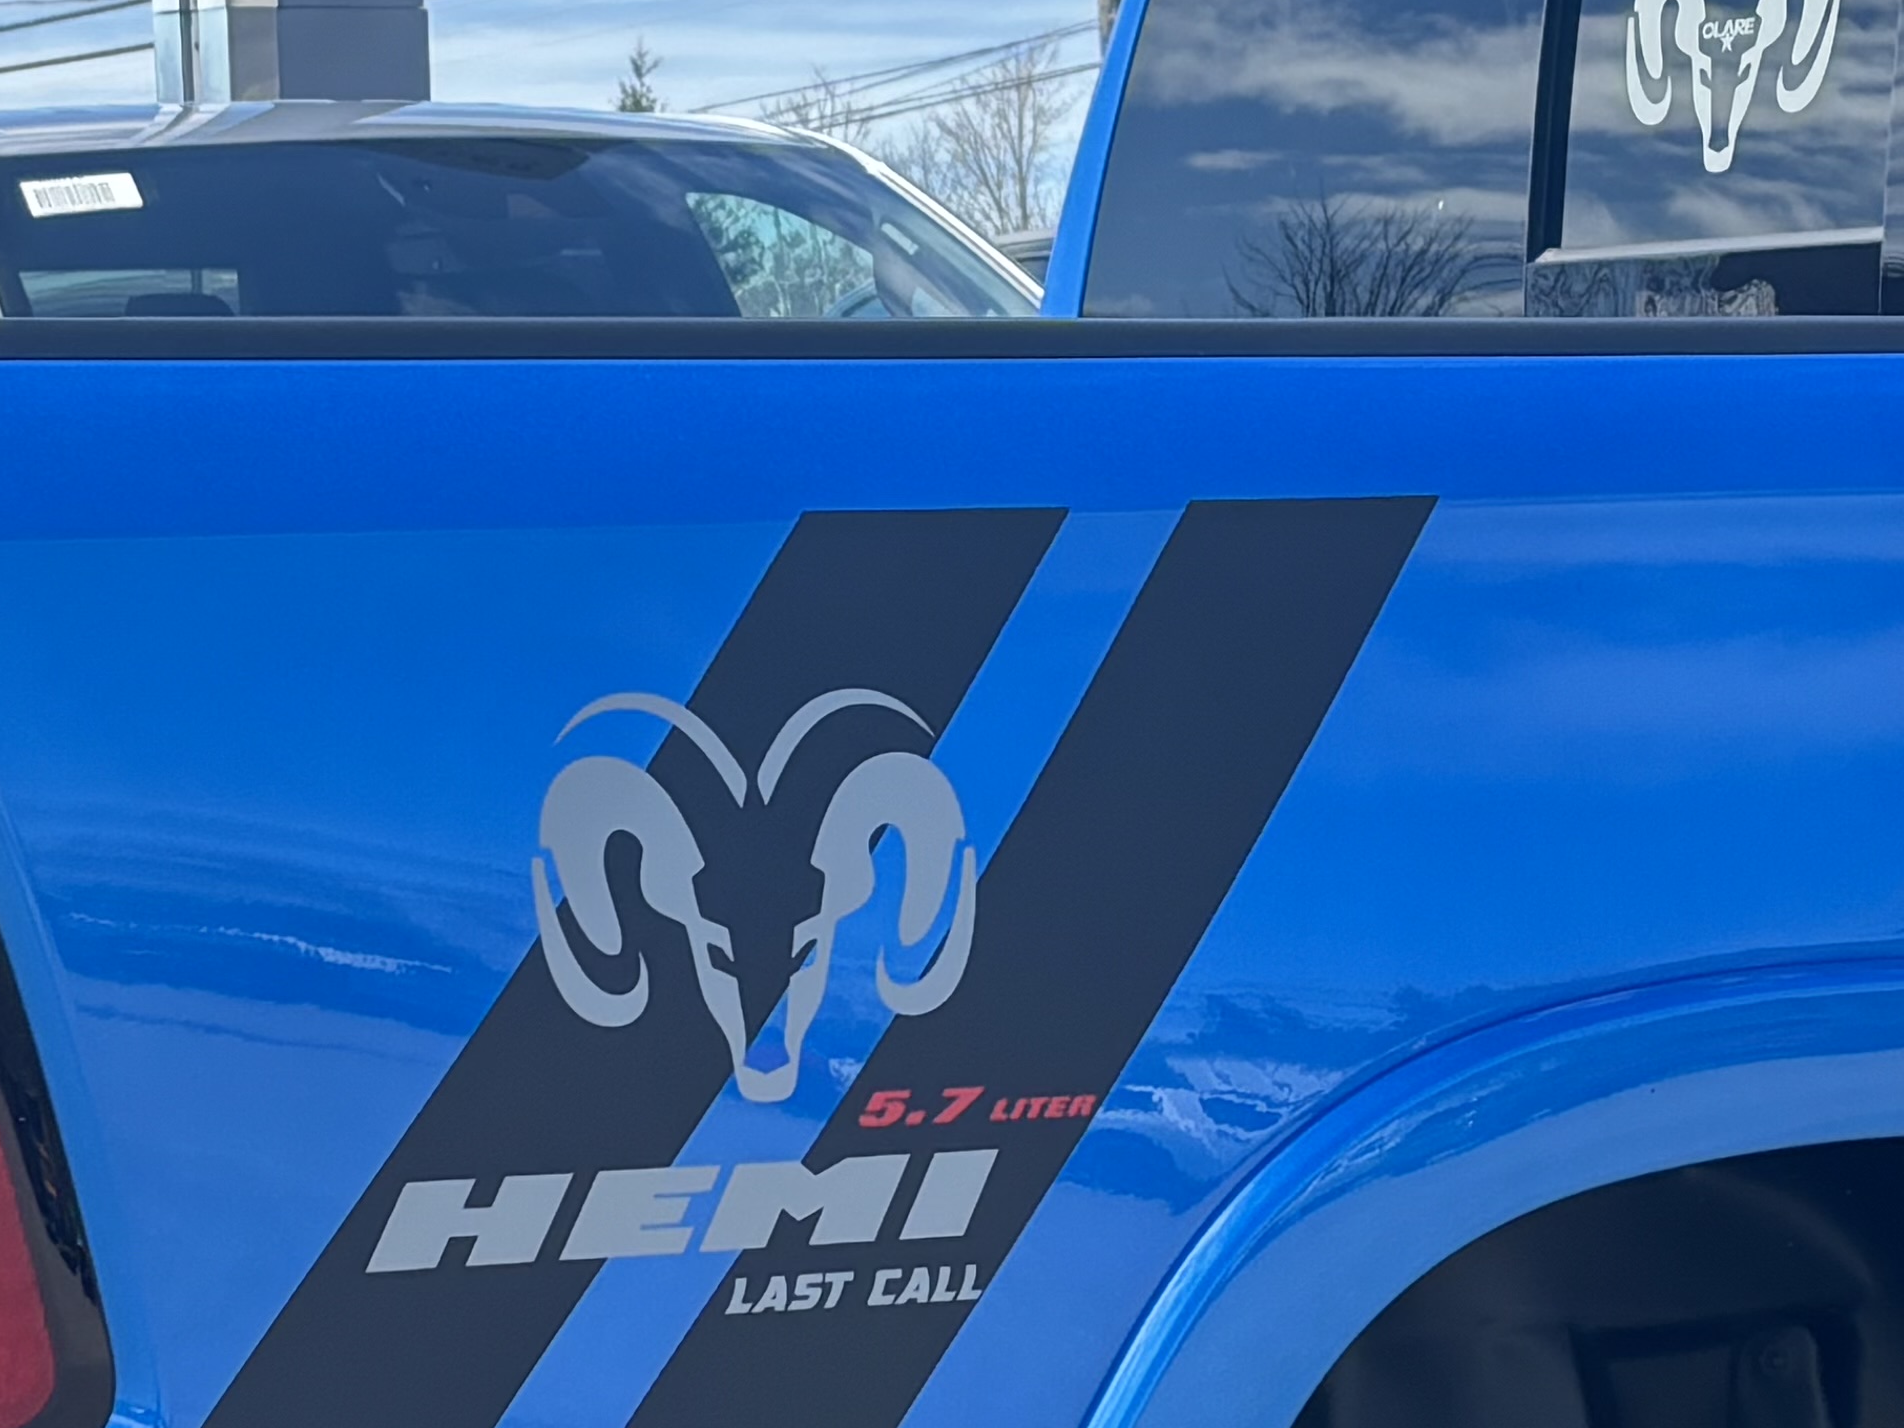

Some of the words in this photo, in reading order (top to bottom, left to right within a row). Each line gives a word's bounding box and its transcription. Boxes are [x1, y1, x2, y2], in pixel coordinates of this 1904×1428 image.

[859, 1086, 985, 1128] 5.7
[990, 1095, 1097, 1121] LITER
[366, 1149, 999, 1274] HEMI
[724, 1271, 854, 1315] LAST
[867, 1264, 982, 1306] CALL
